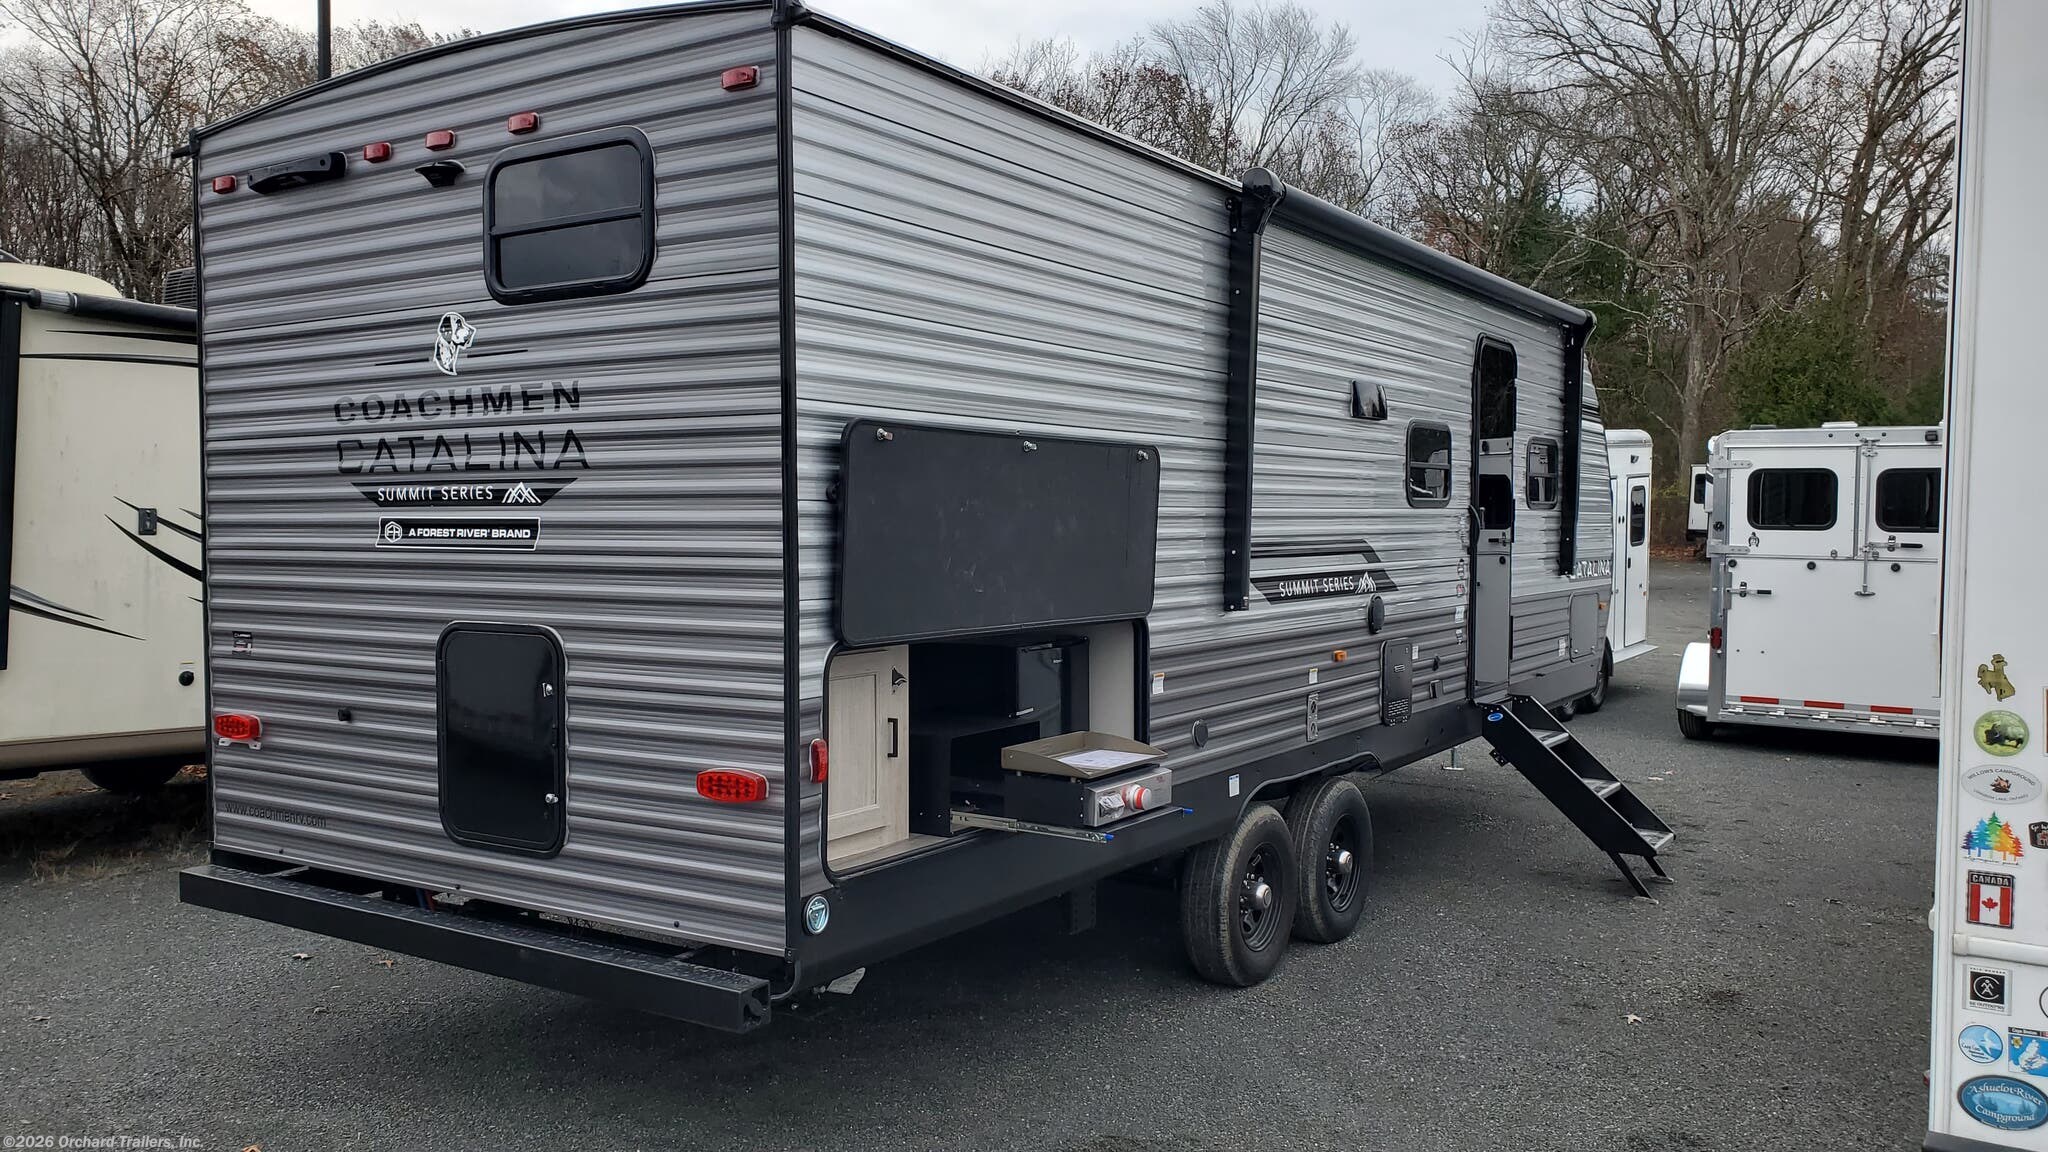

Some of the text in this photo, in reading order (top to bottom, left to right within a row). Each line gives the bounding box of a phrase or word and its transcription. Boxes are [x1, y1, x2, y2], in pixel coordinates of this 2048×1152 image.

[334, 380, 581, 425] COACHMEN
[336, 429, 592, 474] CATALINA
[377, 485, 494, 501] SUMMIT SERIES
[408, 529, 416, 537] A
[417, 528, 456, 538] FOREST
[491, 528, 531, 538] BRAND
[1569, 560, 1611, 579] ATALINA
[1279, 576, 1355, 597] SUMMIT SERIES
[224, 801, 327, 828] www.coachmenrv.com
[1972, 874, 2009, 886] CANADA
[1975, 1104, 2035, 1124] Campground
